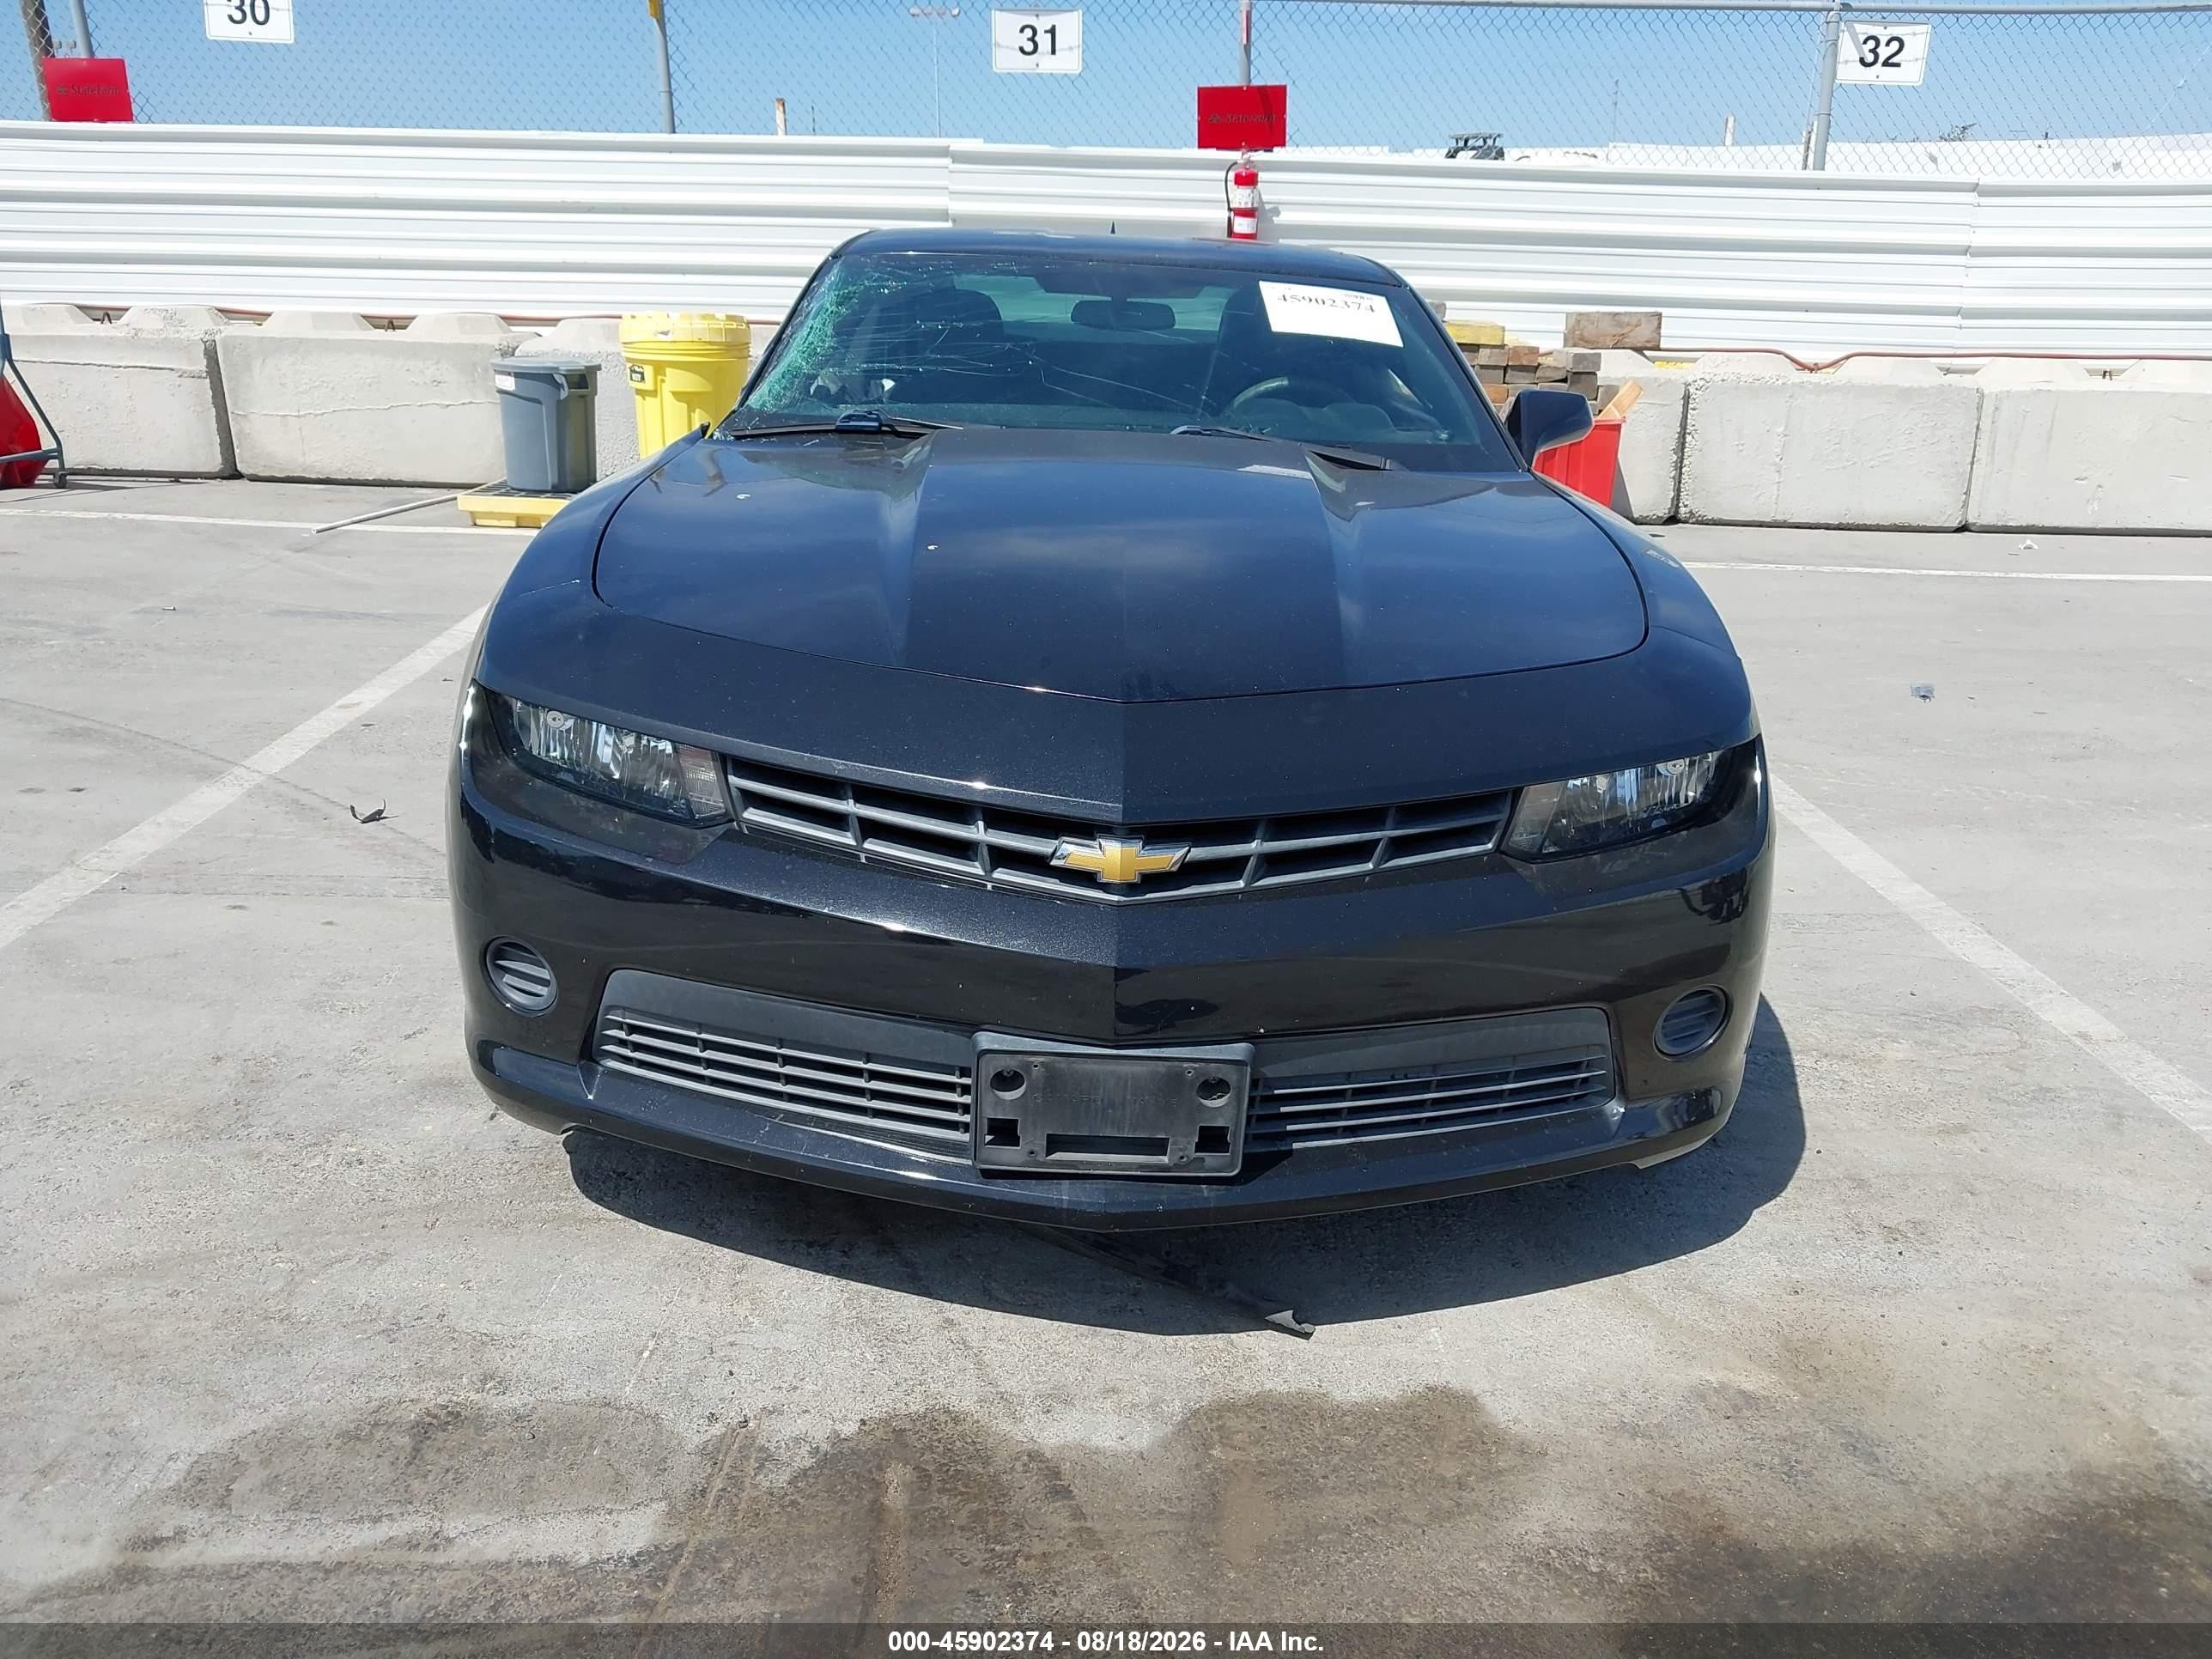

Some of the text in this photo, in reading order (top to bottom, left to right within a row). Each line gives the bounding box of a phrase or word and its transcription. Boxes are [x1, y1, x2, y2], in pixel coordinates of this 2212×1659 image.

[227, 0, 270, 26] 30
[1018, 23, 1057, 57] 31
[1858, 34, 1905, 68] 32
[1277, 293, 1376, 313] 45902374
